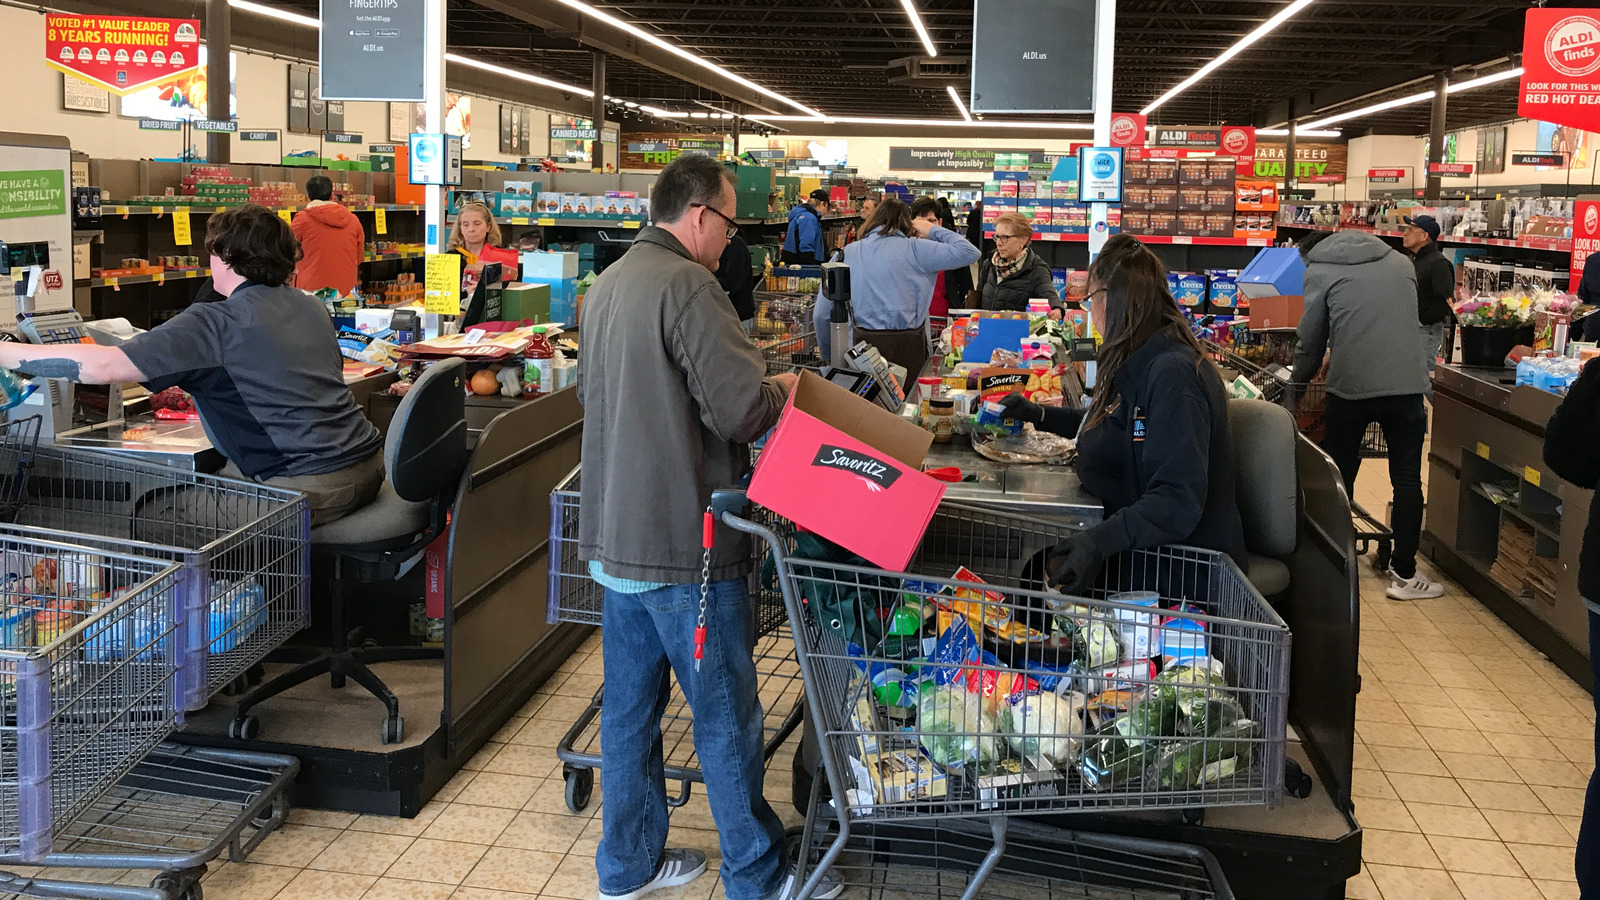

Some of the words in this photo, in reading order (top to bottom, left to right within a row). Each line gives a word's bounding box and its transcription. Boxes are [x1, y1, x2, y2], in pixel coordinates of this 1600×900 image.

[349, 0, 398, 8] FINGERTIPS
[49, 17, 81, 29] VOTED
[83, 19, 96, 29] #1
[98, 19, 129, 31] VALUE
[132, 21, 170, 32] LEADER
[48, 29, 57, 41] 8
[60, 30, 101, 44] YEARS
[104, 31, 169, 46] RUNNING!
[1559, 31, 1593, 47] ALDI
[1022, 51, 1047, 60] ALDI.us
[1563, 47, 1595, 61] finds
[1526, 82, 1549, 90] LOOK
[1570, 83, 1589, 91] THIS
[66, 95, 107, 109] IRRESISTIBLE
[1525, 94, 1549, 104] RED
[1552, 94, 1576, 104] HOT
[1579, 94, 1600, 105] DEA
[142, 120, 159, 129] DRIED
[160, 121, 178, 130] FRUIT
[196, 120, 235, 131] VEGETABLES
[249, 132, 268, 140] CANDY
[335, 134, 351, 142] FRUIT
[551, 129, 578, 138] CANNED
[578, 130, 597, 139] MEAT
[1160, 131, 1187, 141] ALDI
[1187, 131, 1216, 141] finds
[644, 151, 681, 163] FRE
[910, 149, 954, 159] Impressively
[955, 150, 971, 160] High
[972, 150, 995, 159] Qualit
[946, 159, 984, 169] Impossibly
[1254, 162, 1328, 177] UAITY
[10, 179, 31, 189] HAVE
[33, 179, 39, 188] A
[0, 189, 61, 202] ONSIBILITY
[1575, 238, 1591, 251] LOOK
[1592, 239, 1600, 251] FO
[1574, 250, 1586, 261] NEW
[45, 275, 59, 283] UTZ
[1180, 281, 1203, 289] Cheerios
[1212, 282, 1236, 290] Cheerios
[986, 374, 1022, 387] Savoritz
[820, 449, 887, 479] Savoritz
